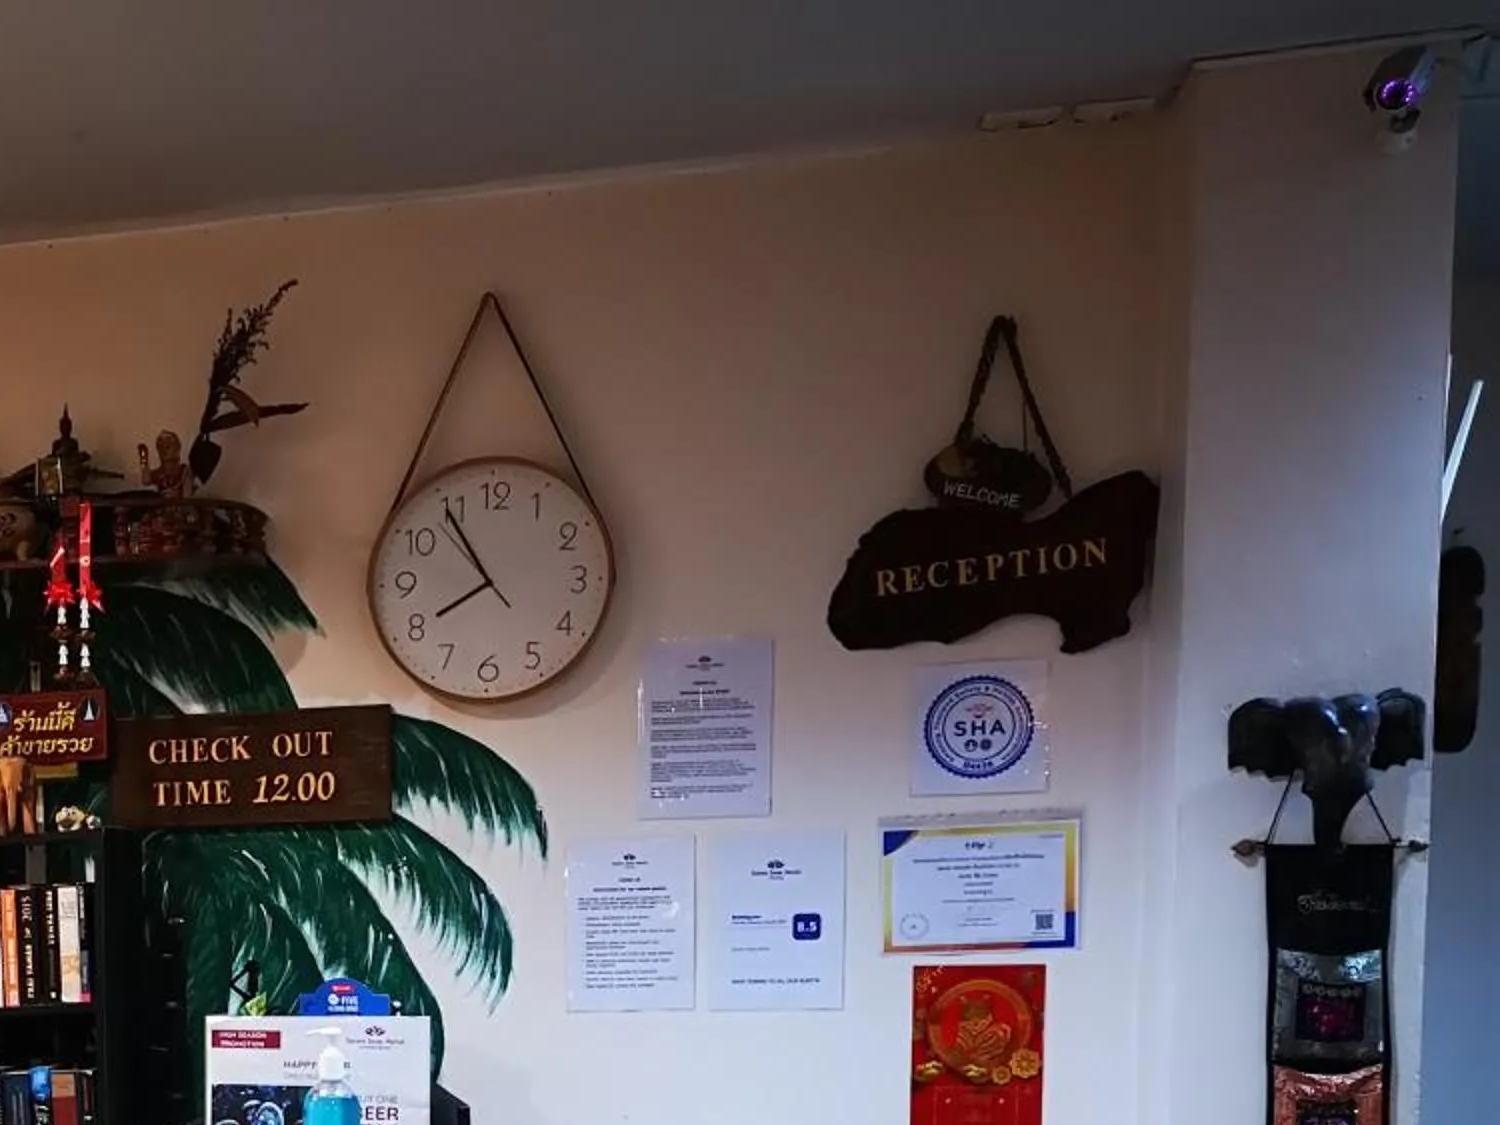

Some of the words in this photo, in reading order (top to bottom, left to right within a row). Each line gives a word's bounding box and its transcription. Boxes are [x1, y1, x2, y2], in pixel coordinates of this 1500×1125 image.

[479, 481, 511, 511] 12
[531, 492, 541, 522] 1
[942, 480, 1023, 509] WELCOME
[441, 495, 466, 525] 11
[404, 527, 437, 556] 10
[558, 521, 578, 551] 2
[569, 565, 588, 594] 3
[875, 537, 1108, 597] RECEPTION
[394, 570, 418, 600] 9
[407, 613, 425, 642] 8
[555, 610, 574, 637] 4
[437, 643, 456, 671] 7
[477, 654, 500, 683] 6
[524, 641, 542, 670] 5
[953, 719, 1006, 737] SHA
[148, 735, 251, 765] CHECK
[272, 731, 333, 758] OUT
[153, 779, 232, 807] TIME
[253, 771, 335, 804] 12.00
[360, 1106, 400, 1121] EER
